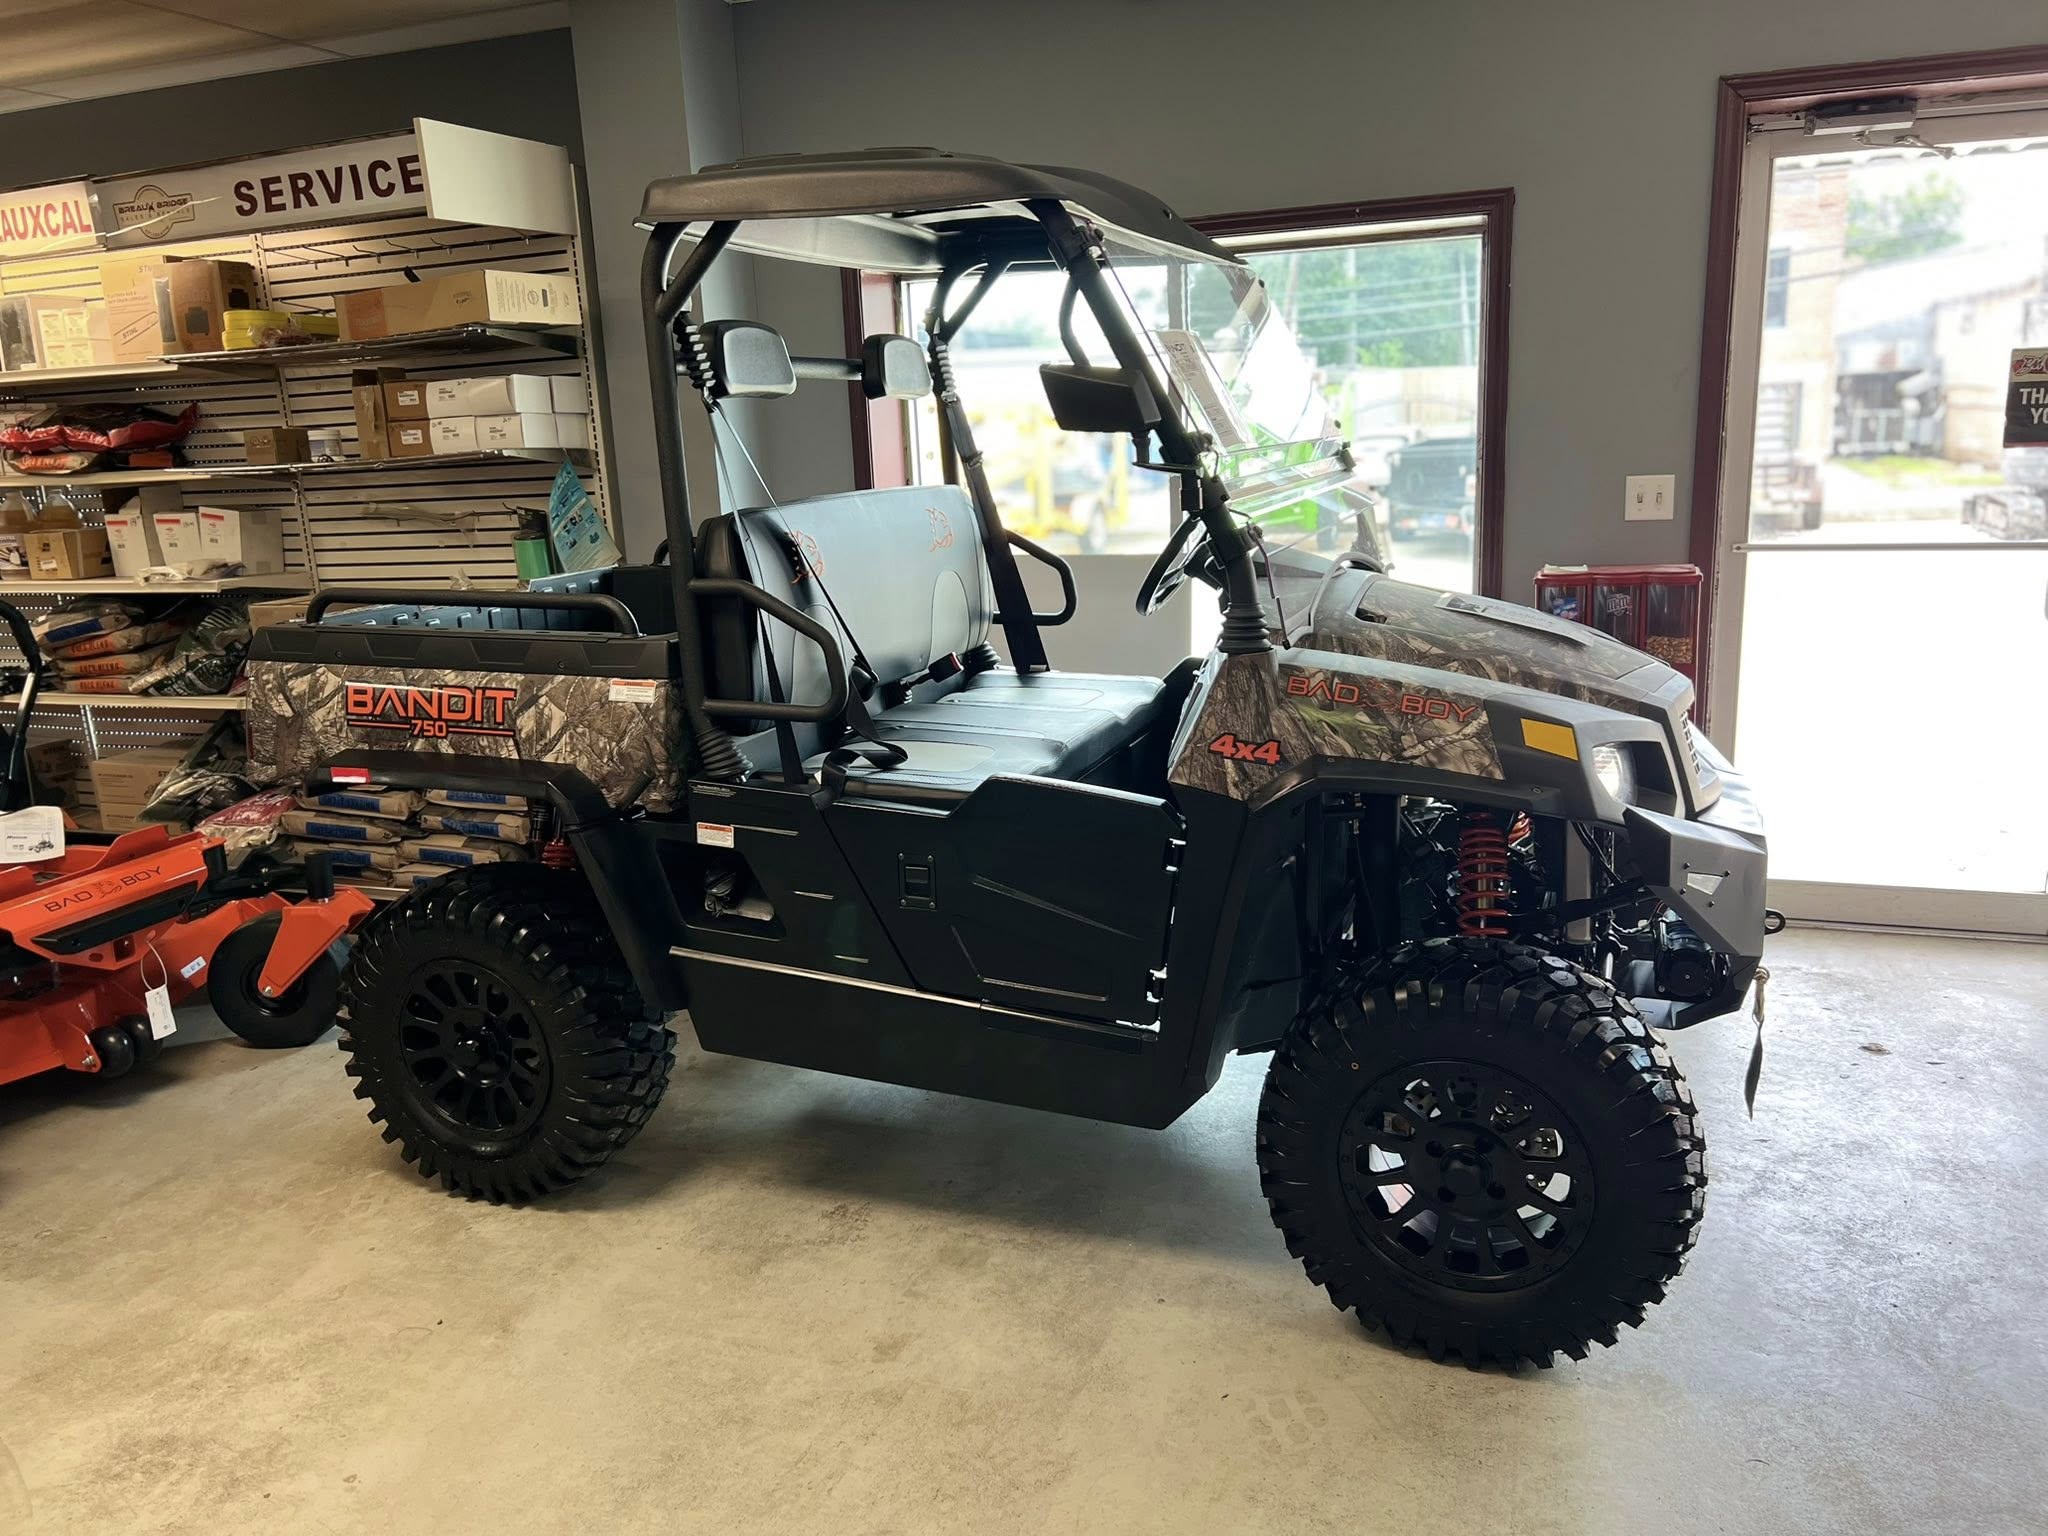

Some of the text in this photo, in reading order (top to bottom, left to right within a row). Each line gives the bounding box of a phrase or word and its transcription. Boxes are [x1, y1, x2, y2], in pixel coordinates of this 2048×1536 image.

[118, 198, 188, 214] BREAUX BRIDGE
[233, 154, 424, 216] SERVICE
[0, 200, 92, 242] AUXCAL
[346, 683, 517, 725] BANDIT
[1287, 675, 1479, 722] BAD BOY
[410, 719, 448, 738] 750
[1208, 733, 1281, 766] 4x4
[44, 866, 161, 912] BAD BOY
